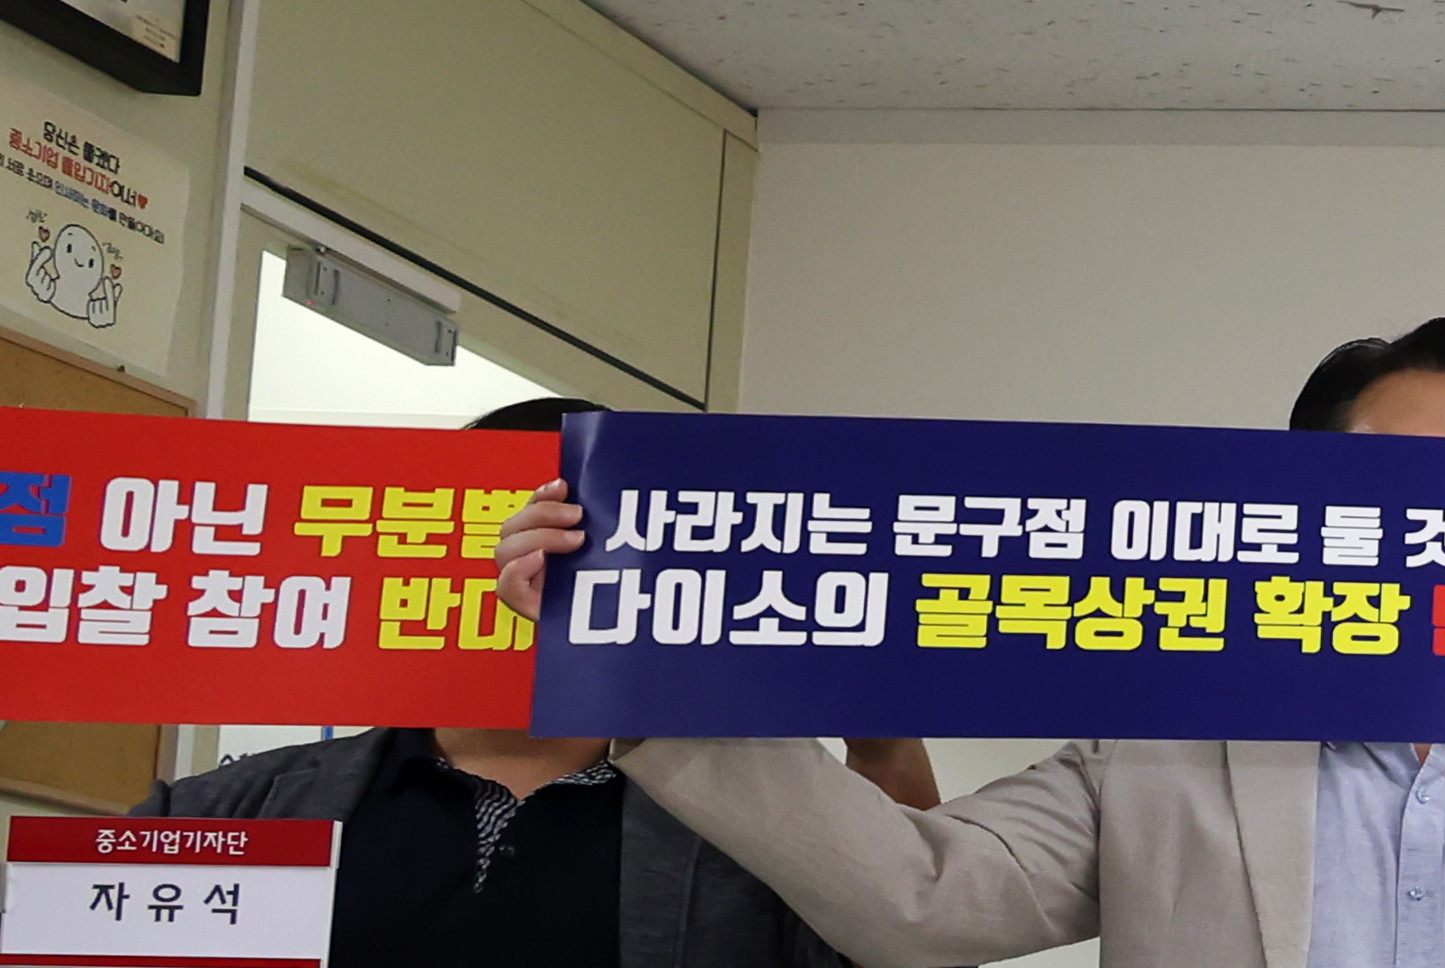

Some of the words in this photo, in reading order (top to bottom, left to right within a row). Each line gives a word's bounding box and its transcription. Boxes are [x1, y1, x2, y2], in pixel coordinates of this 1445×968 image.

[100, 477, 268, 556] 아닌
[605, 489, 873, 555] 사라지는
[893, 494, 1087, 560] 문구점
[1111, 499, 1300, 564] 이대로
[1320, 505, 1384, 567] 둘
[0, 565, 168, 646] 입찰
[187, 569, 352, 649] 참여
[568, 568, 889, 647] 다이소의
[917, 573, 1225, 651] 골목상권
[1254, 577, 1409, 654] 확장
[96, 829, 248, 855] 중소기업기자단
